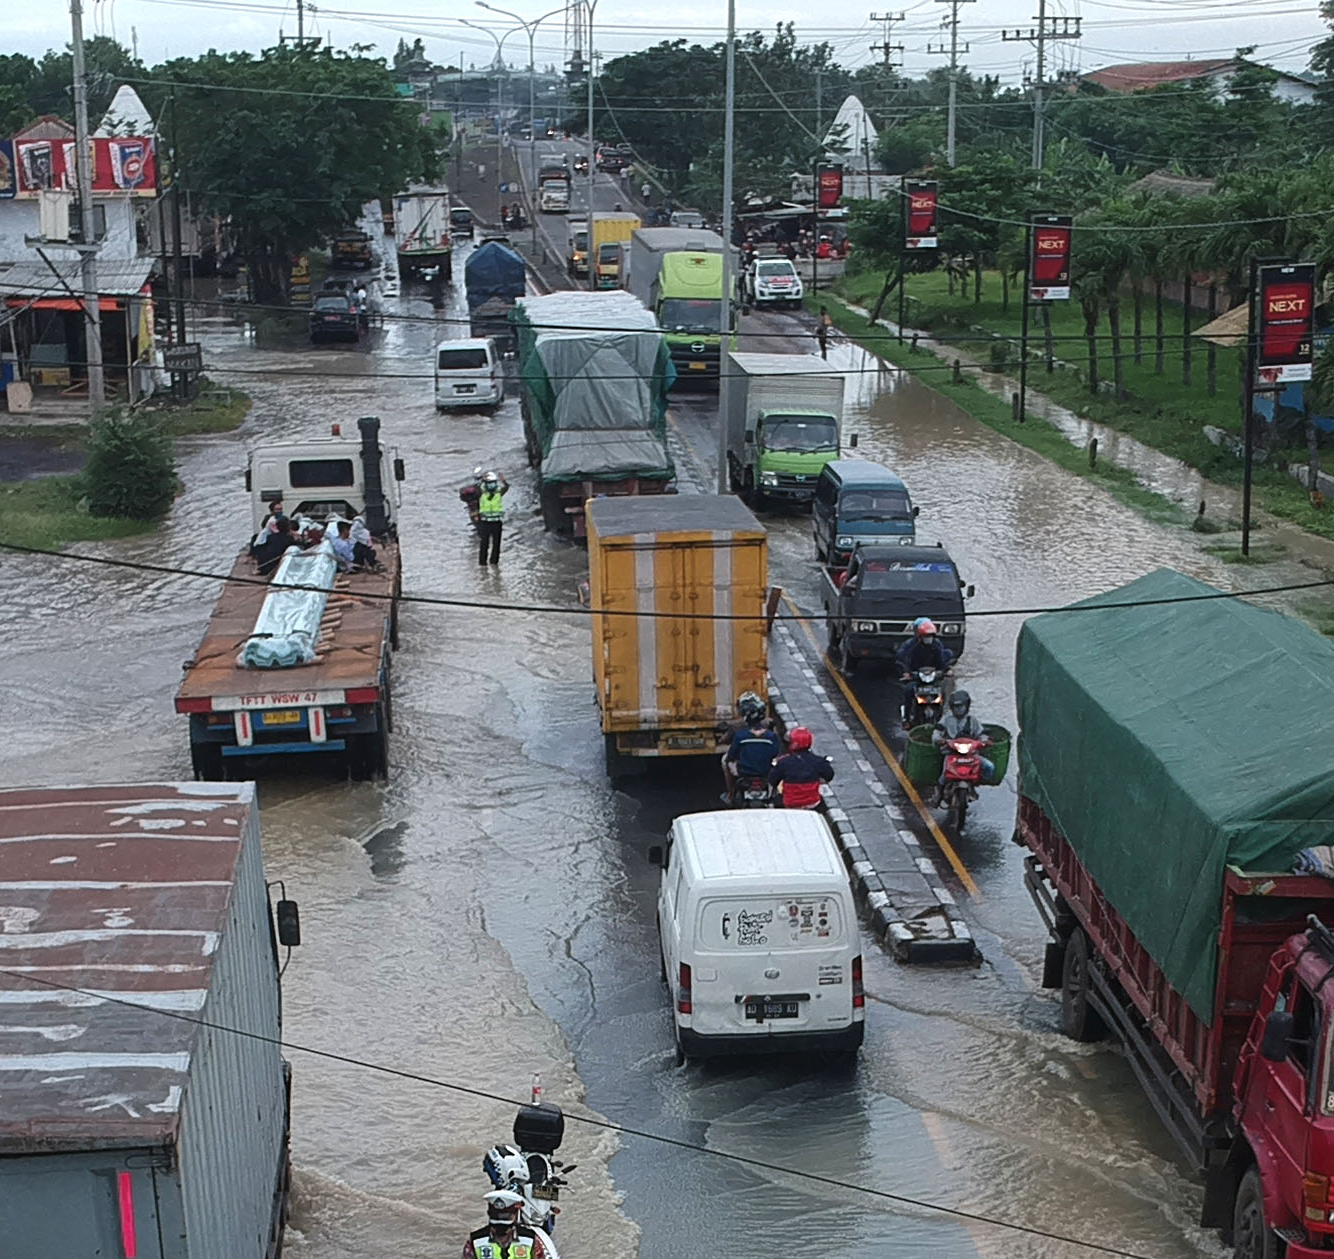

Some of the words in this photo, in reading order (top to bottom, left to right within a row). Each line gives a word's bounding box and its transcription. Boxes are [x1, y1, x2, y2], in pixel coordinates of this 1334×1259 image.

[1038, 240, 1065, 249] NEXT
[1269, 299, 1305, 313] NEXT
[1300, 344, 1310, 352] 12
[271, 693, 300, 704] WSW
[304, 692, 317, 702] 47
